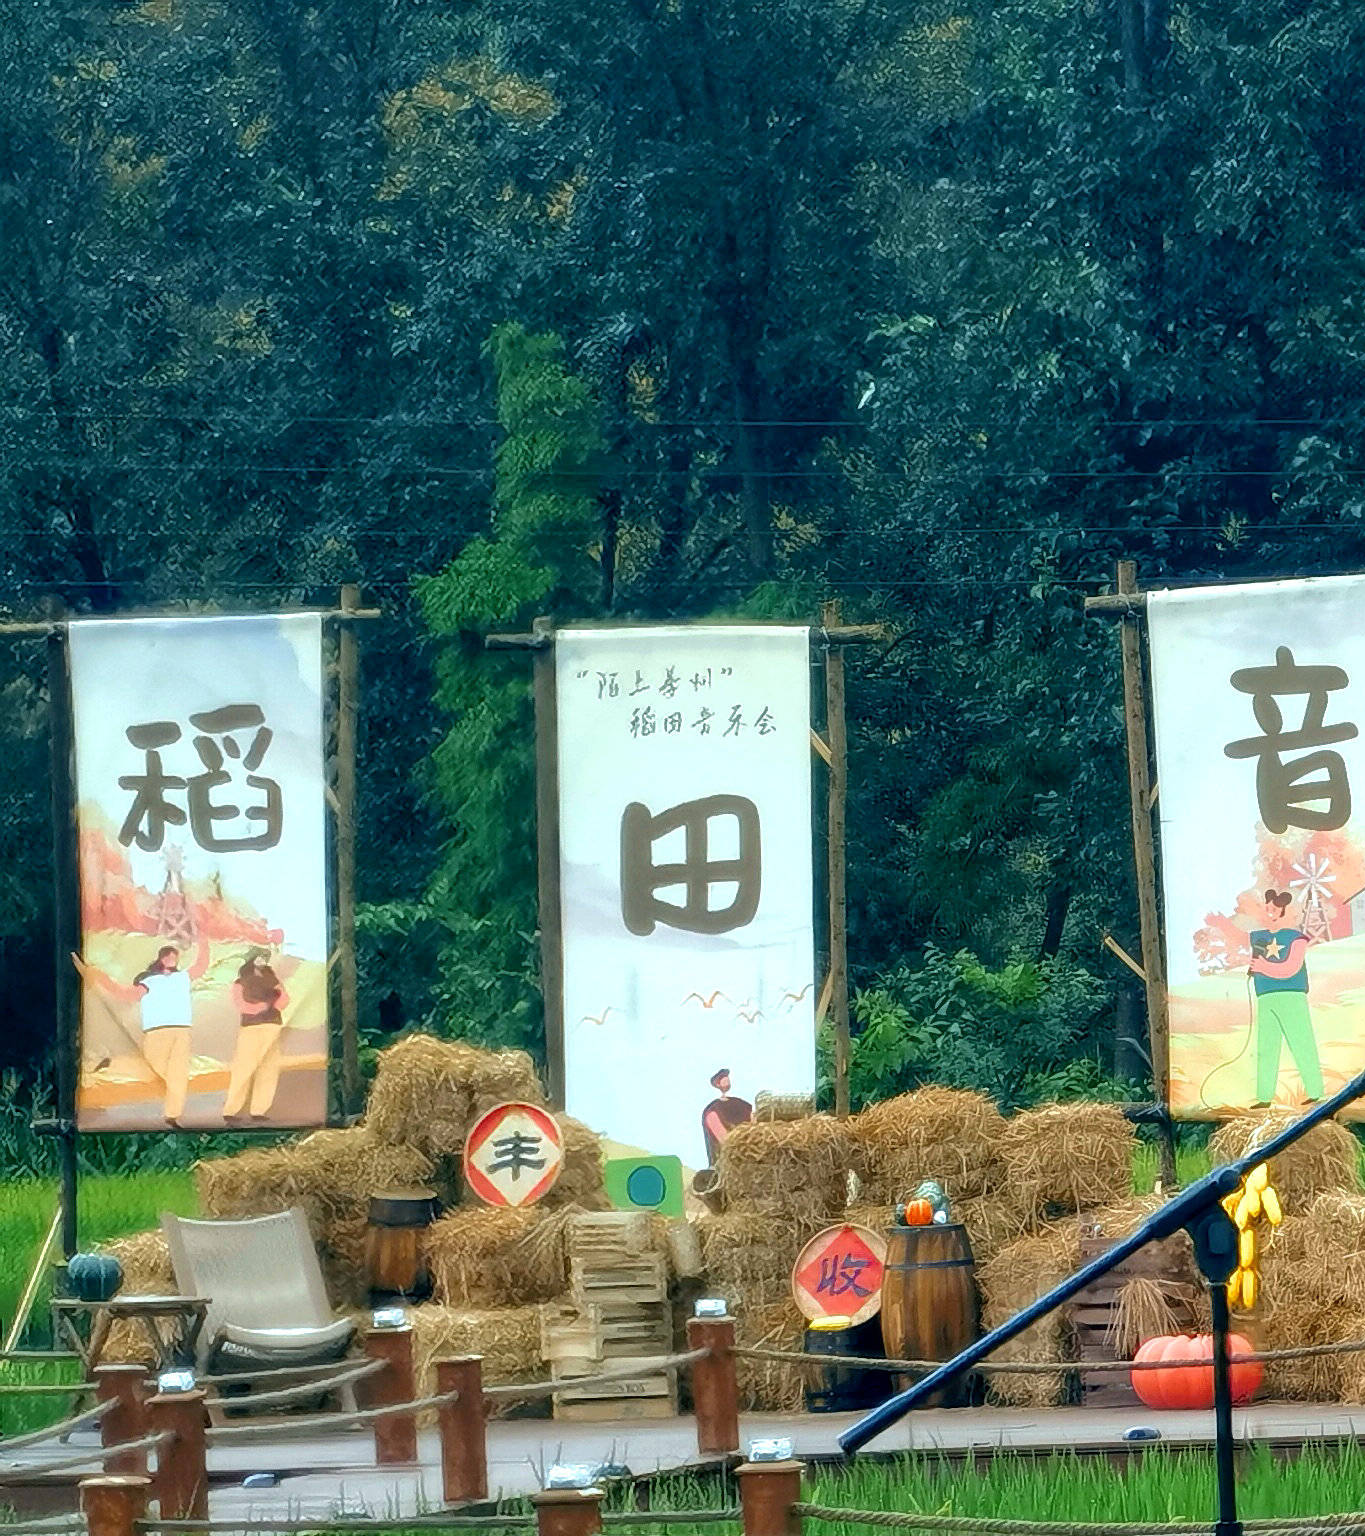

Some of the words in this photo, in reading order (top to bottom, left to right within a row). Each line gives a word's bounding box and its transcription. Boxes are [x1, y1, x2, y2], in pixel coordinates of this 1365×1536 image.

[629, 704, 777, 738] 稻田音乐会
[1223, 645, 1359, 835] 音
[118, 704, 283, 853] 稻
[620, 794, 762, 937] 田
[486, 1130, 546, 1182] 丰
[815, 1252, 881, 1298] 收
